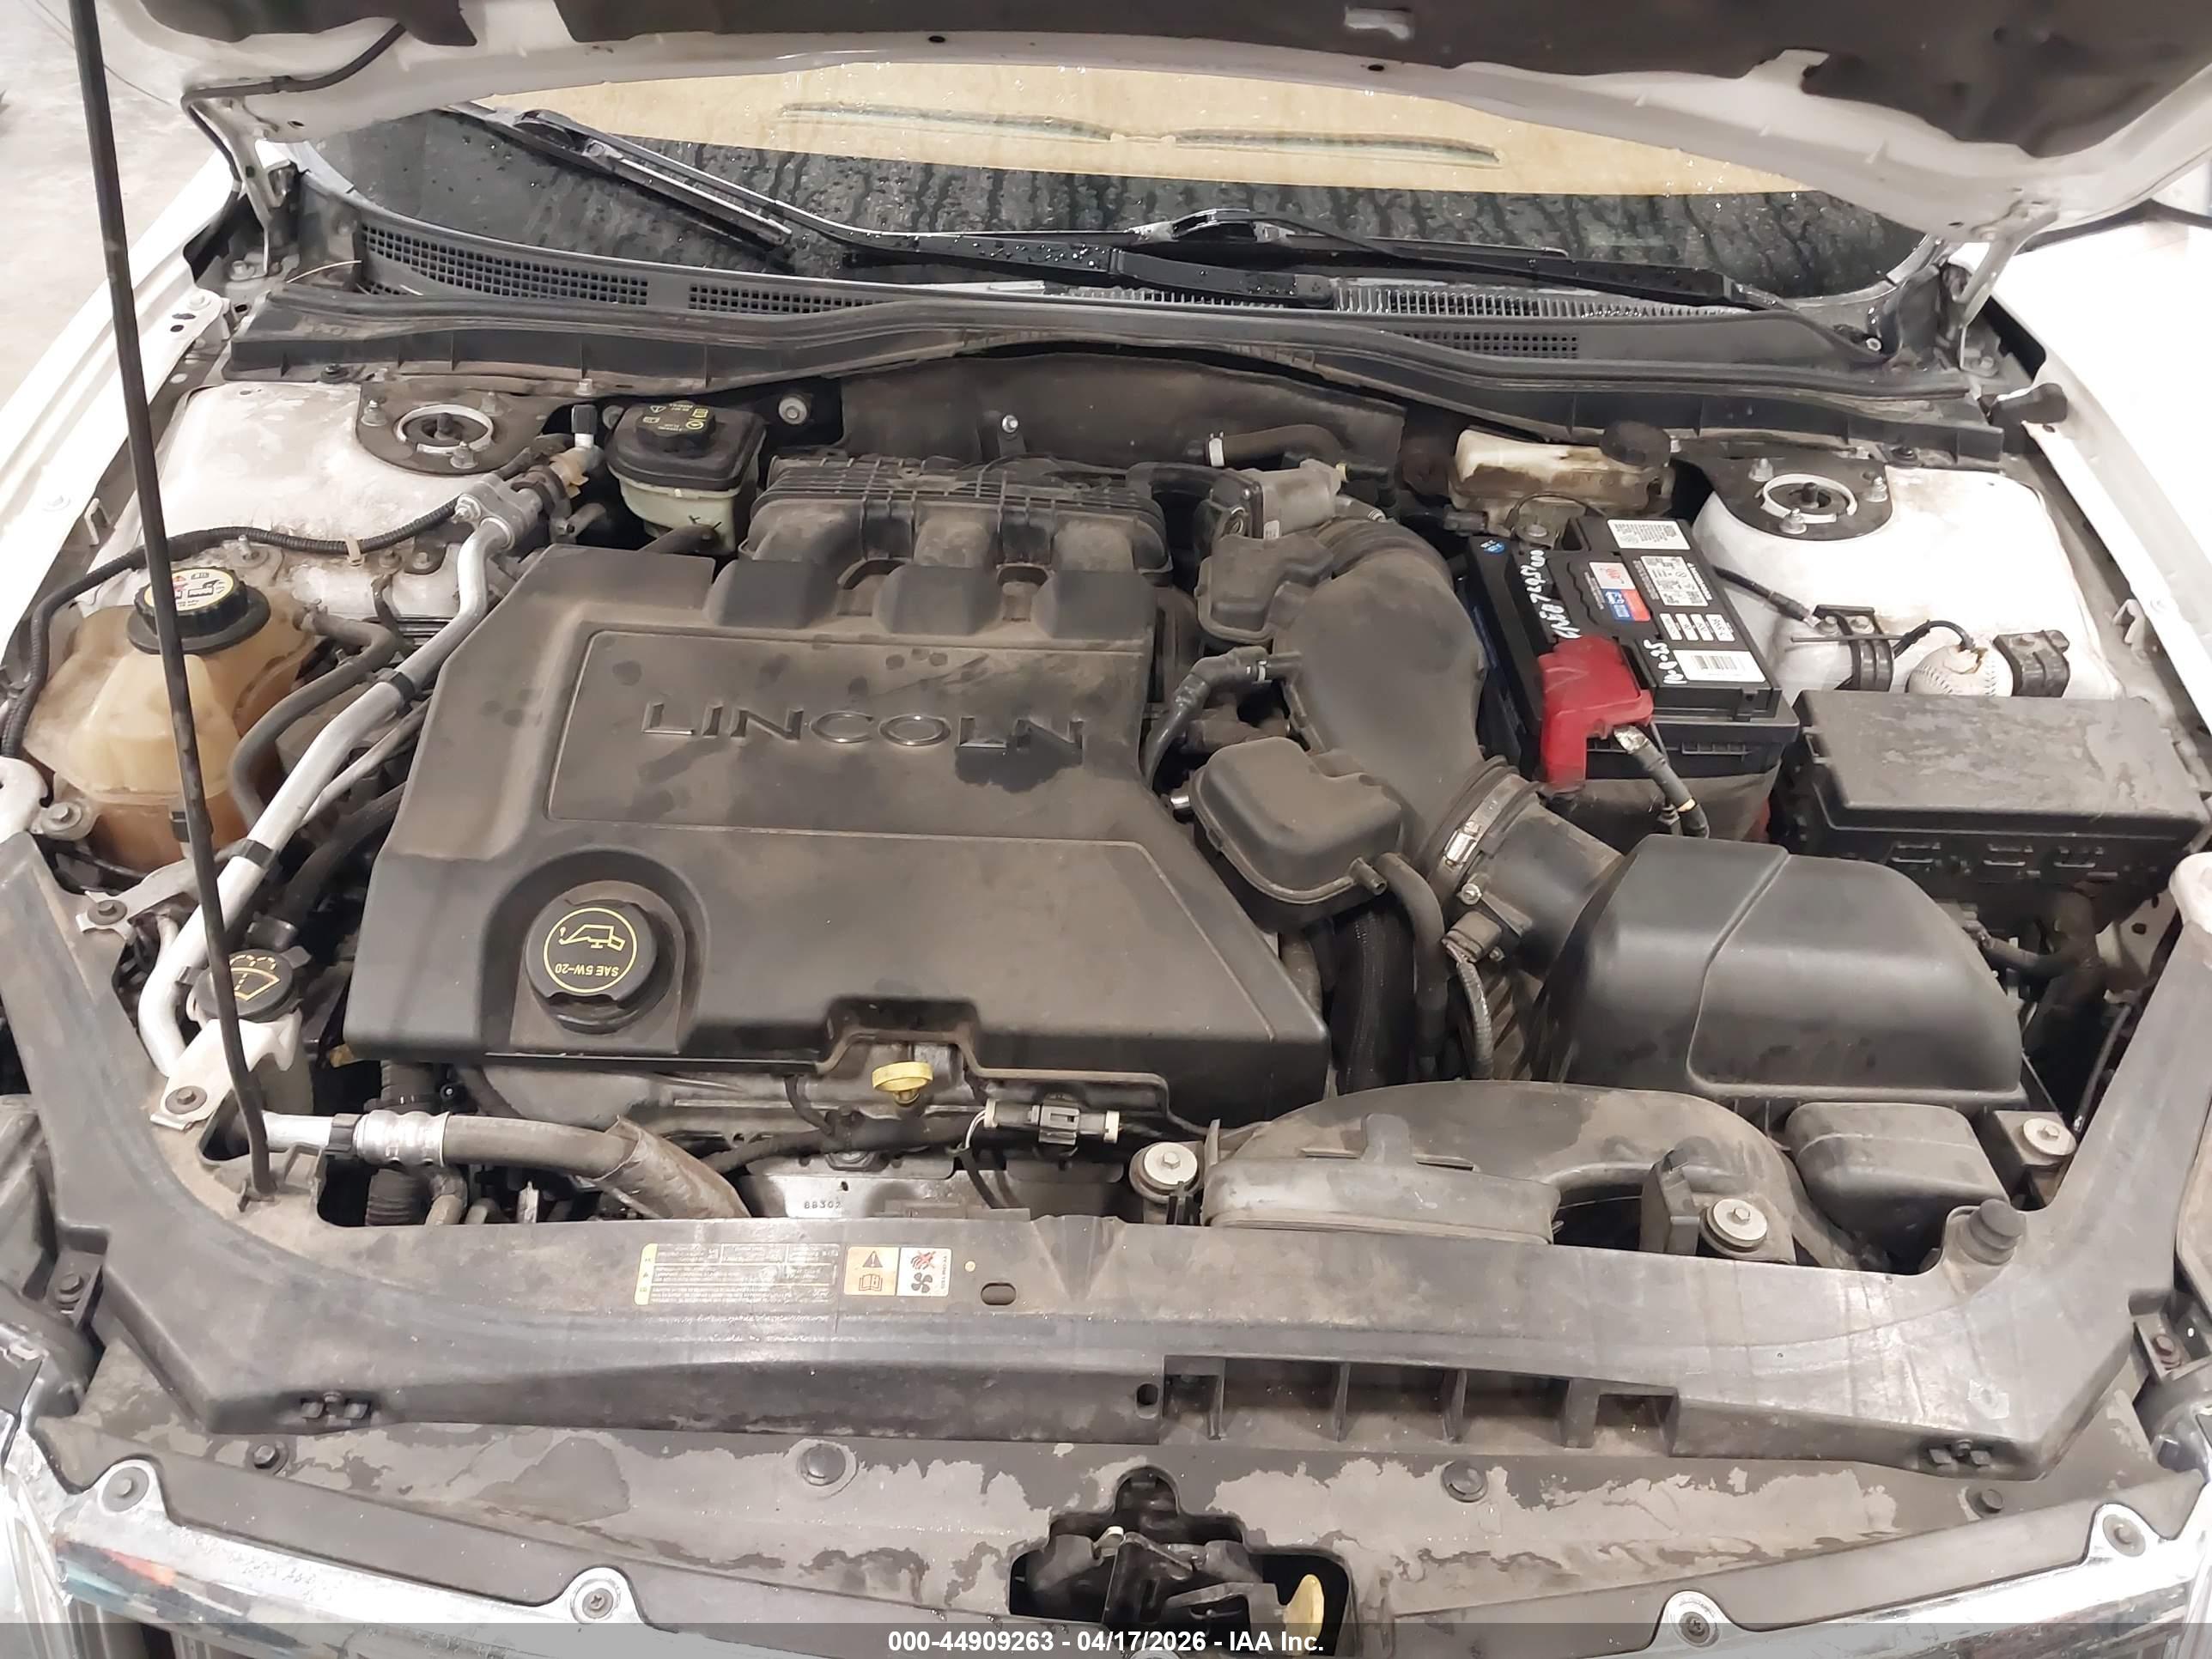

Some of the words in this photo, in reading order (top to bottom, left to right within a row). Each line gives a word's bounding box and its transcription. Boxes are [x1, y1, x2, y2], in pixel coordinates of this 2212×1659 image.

[641, 701, 1084, 750] LINCOLN
[555, 963, 592, 976] 5W-20
[595, 965, 619, 977] SAE
